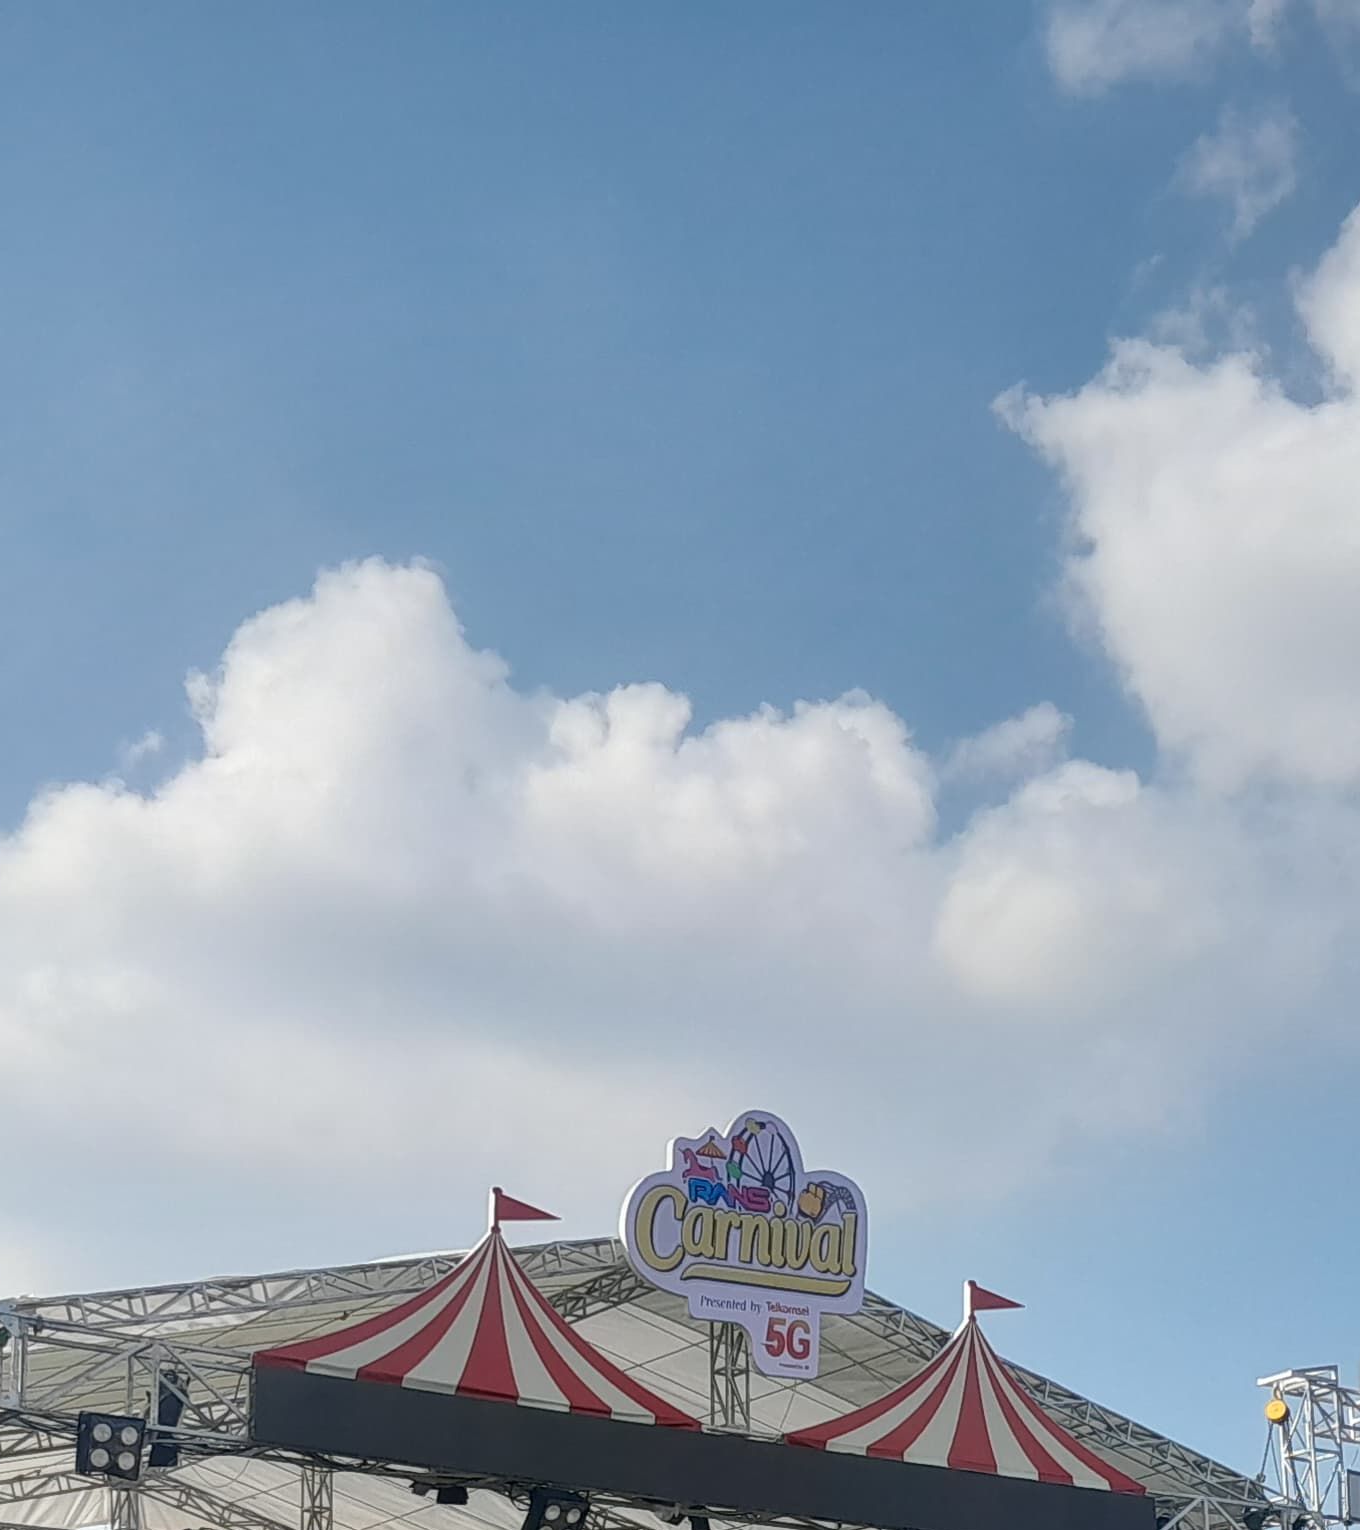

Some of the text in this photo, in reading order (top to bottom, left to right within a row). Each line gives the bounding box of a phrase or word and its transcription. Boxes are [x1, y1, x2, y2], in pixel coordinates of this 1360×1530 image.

[688, 1177, 772, 1214] RANS
[634, 1184, 857, 1278] Carnival
[700, 1295, 810, 1317] Presented by Telkomsel
[762, 1316, 811, 1361] 5G
